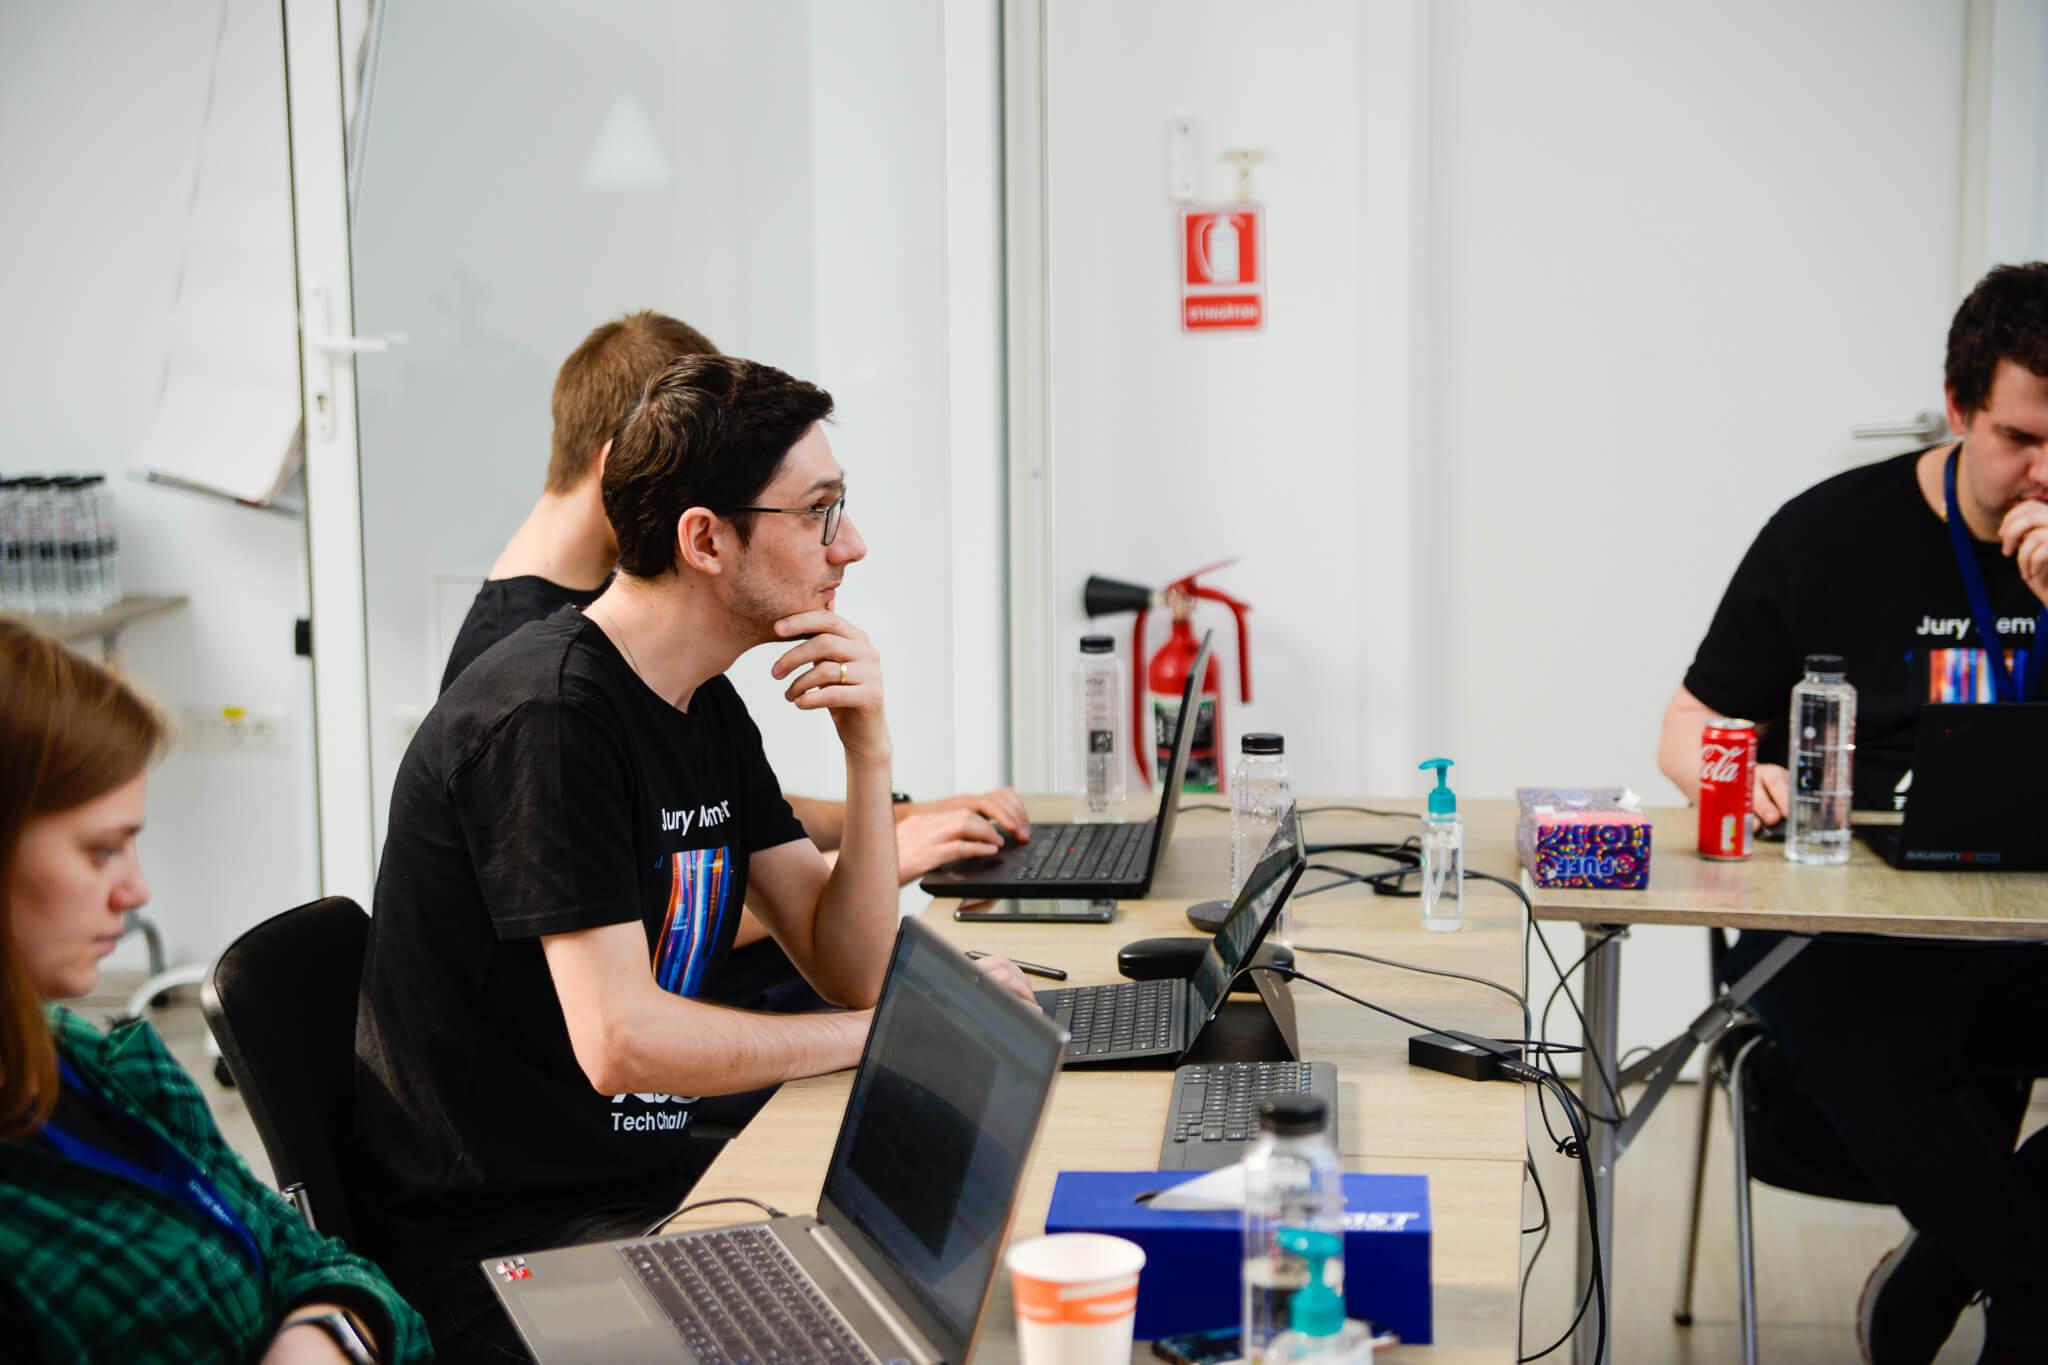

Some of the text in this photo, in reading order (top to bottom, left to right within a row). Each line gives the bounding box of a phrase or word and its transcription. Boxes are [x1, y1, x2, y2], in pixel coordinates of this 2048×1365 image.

[1915, 615, 1971, 640] Jury
[661, 807, 695, 836] Jury
[611, 1111, 655, 1131] Tech
